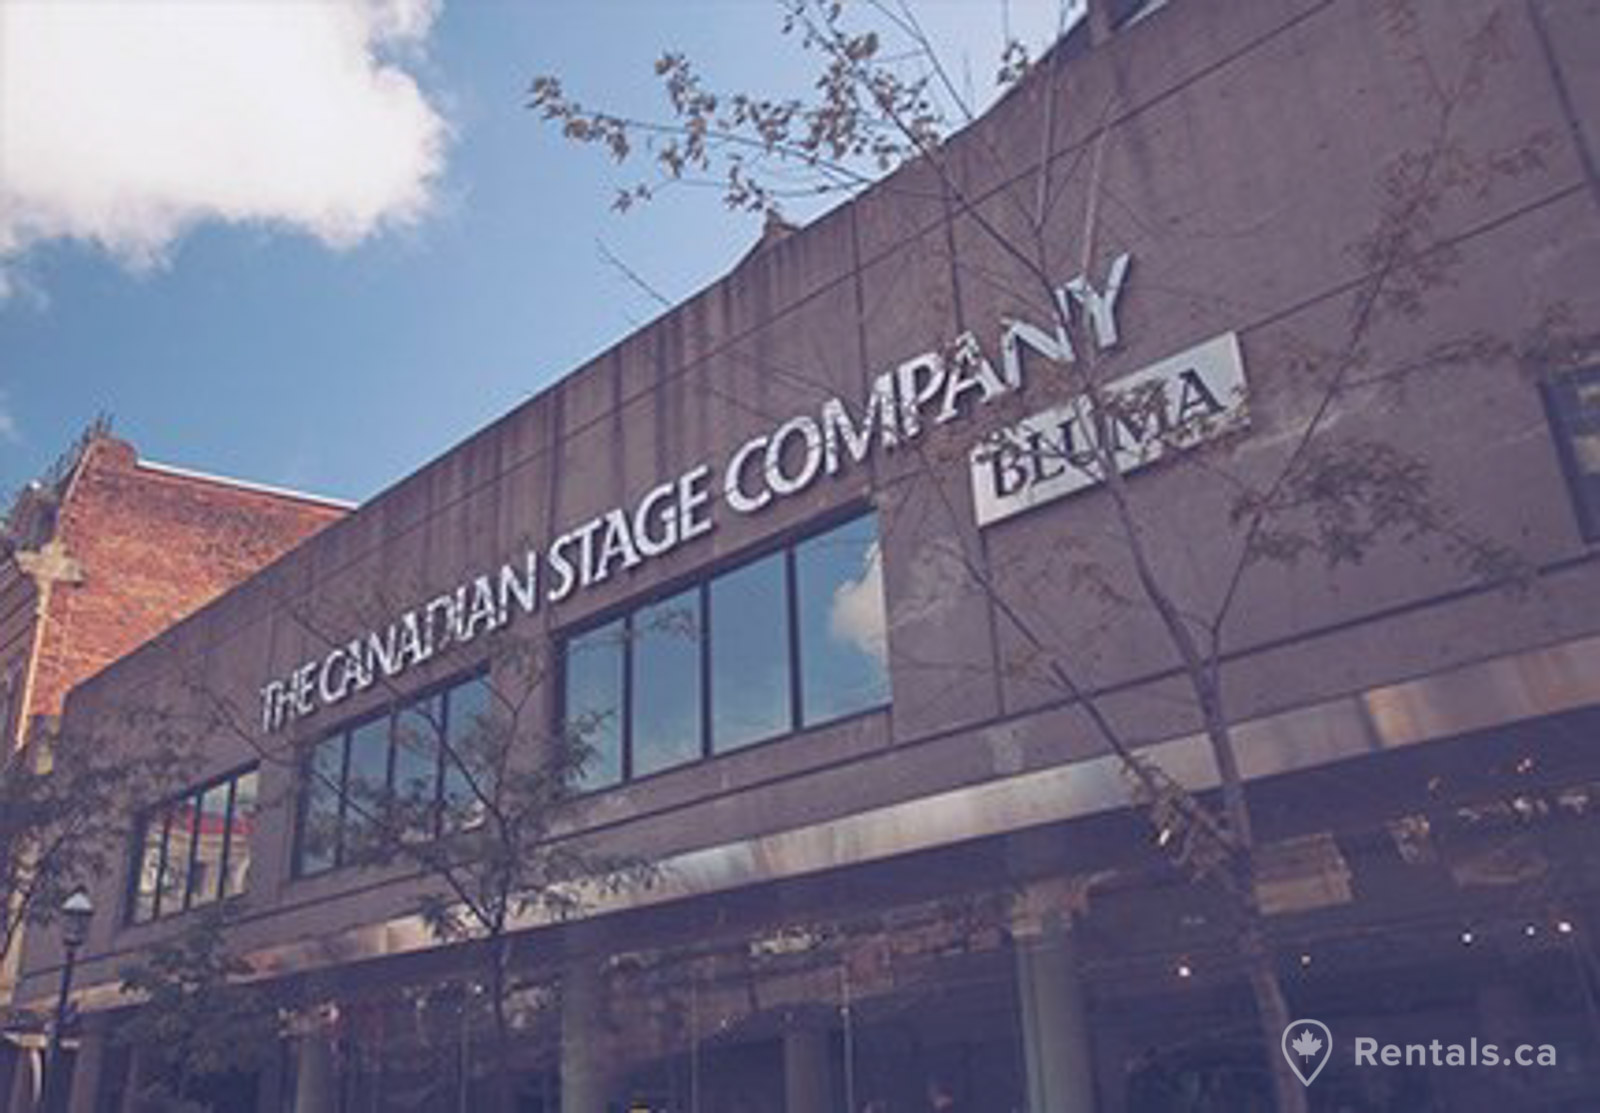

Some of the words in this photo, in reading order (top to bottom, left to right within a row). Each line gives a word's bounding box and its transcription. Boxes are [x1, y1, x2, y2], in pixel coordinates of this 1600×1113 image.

[260, 661, 317, 733] THE
[319, 550, 537, 704] CANADIAN
[548, 463, 713, 601] STAGE
[724, 253, 1131, 513] COMPANY
